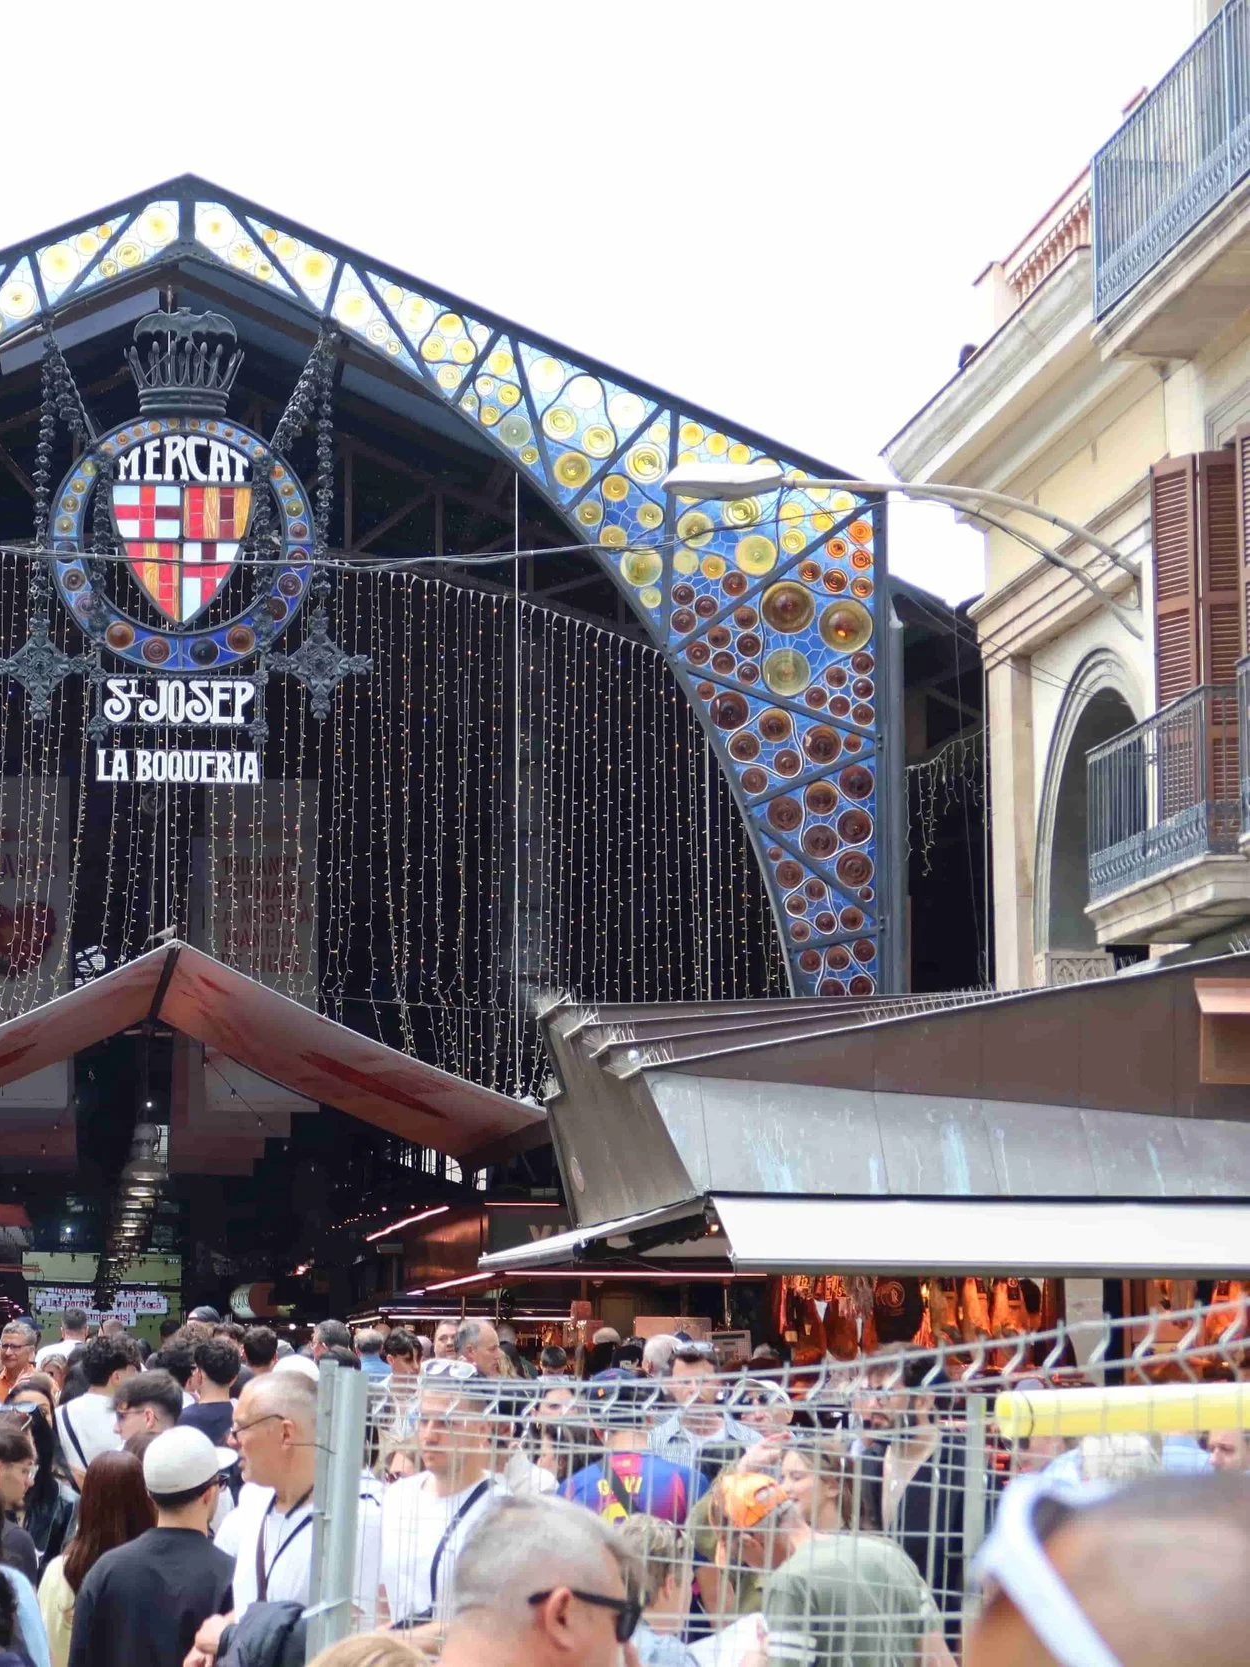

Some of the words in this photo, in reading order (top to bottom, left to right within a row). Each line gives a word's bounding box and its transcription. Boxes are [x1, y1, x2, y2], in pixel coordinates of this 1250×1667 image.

[118, 435, 249, 481] MERCAT
[138, 679, 255, 724] JOSEP
[96, 749, 129, 782] LA
[135, 750, 260, 783] BOQUERIA
[597, 1475, 643, 1496] GVI
